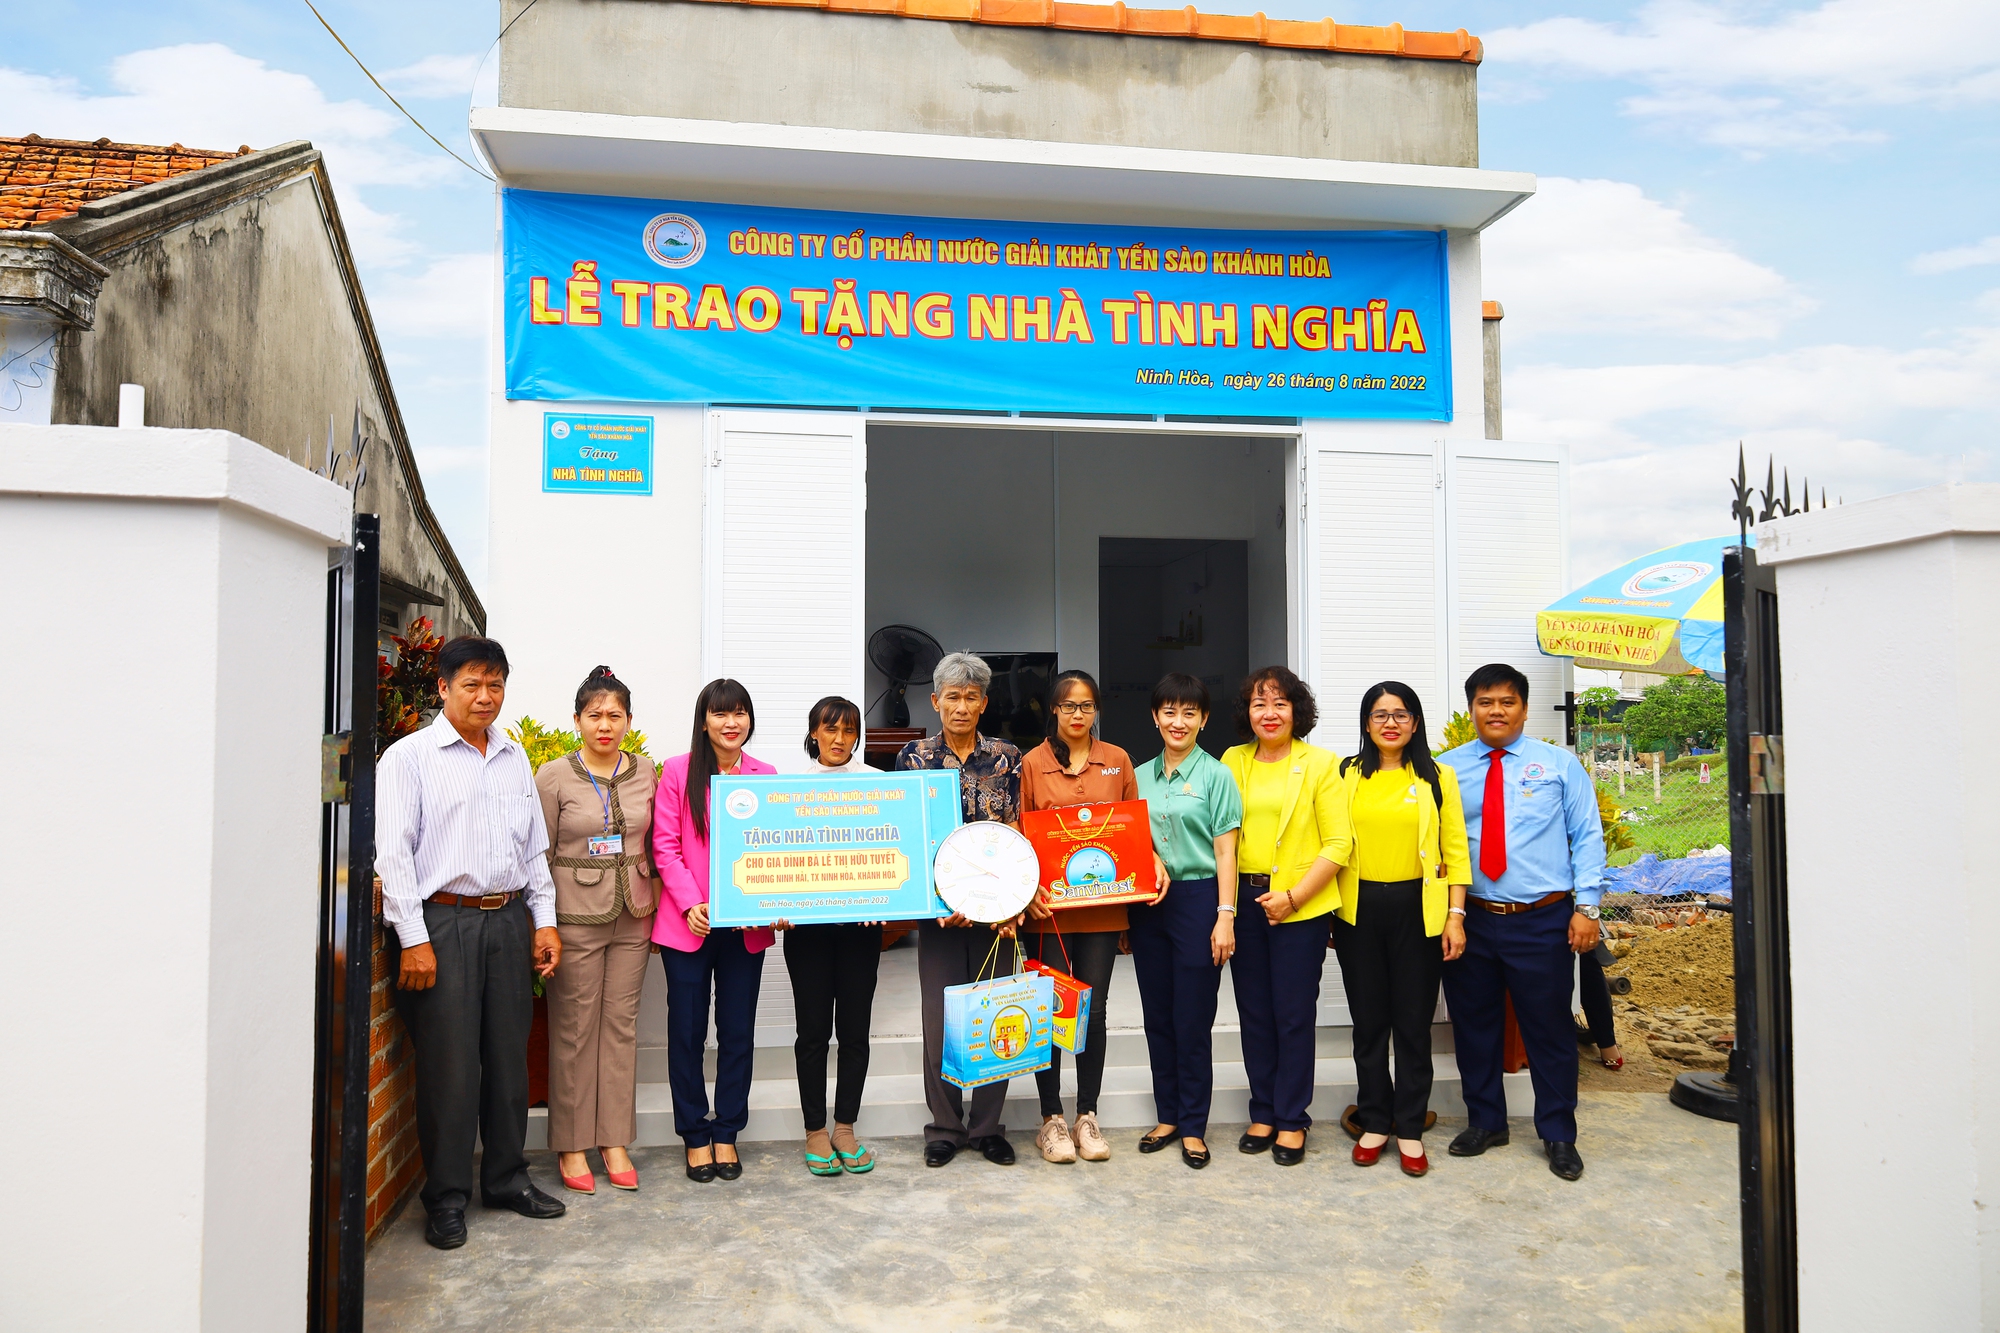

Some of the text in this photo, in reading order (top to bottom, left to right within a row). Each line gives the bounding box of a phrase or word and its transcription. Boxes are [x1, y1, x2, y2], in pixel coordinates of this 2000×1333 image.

[729, 227, 793, 256] CÔNG
[799, 234, 825, 258] TY
[832, 228, 866, 260] CỔ
[869, 232, 932, 262] PHẦN
[938, 235, 999, 264] NƯỚC
[1004, 238, 1049, 267] GIẢI
[1055, 243, 1111, 270] KHÁT
[1116, 242, 1159, 272] YẾN
[1164, 246, 1208, 274] SÀO
[1212, 248, 1284, 277] KHÁNH
[1289, 252, 1332, 278] HÒA
[530, 260, 1427, 354] LỄ TRAO TẶNG NHÀ TÌNH NGHĨA
[1136, 368, 1426, 391] Ninh Hòa, ngày 26 tháng 8 năm 2022
[553, 465, 644, 482] NHÀ TÌNH NGHĨA
[1546, 618, 1660, 641] YẾN SÀO KHÁNH HÒA
[1564, 637, 1585, 652] SÀO
[1587, 640, 1622, 656] THIÊN
[1622, 646, 1659, 661] NHIÊN
[767, 791, 790, 803] CÔNG
[792, 793, 802, 803] TY
[884, 788, 905, 800] KHÁT
[795, 804, 811, 817] YẾN
[813, 805, 830, 816] SÀO
[832, 804, 860, 816] KHÁNH
[743, 823, 900, 849] TẶNG NHÀ TÌNH NGHĨA
[745, 857, 764, 869] CHO
[766, 857, 781, 868] GIA
[784, 854, 805, 867] ĐÌNH
[807, 854, 819, 867] BÀ
[834, 855, 848, 868] THỊ
[776, 874, 794, 883] NINH
[811, 873, 820, 882] TX
[821, 872, 838, 881] NINH
[857, 870, 881, 880] KHÁNH
[1050, 875, 1136, 902] Sanvinest
[759, 900, 776, 908] Ninh
[796, 899, 814, 909] ngày
[815, 898, 824, 907] 26
[825, 898, 847, 908] tháng
[847, 897, 853, 905] 8
[871, 896, 889, 904] 2022
